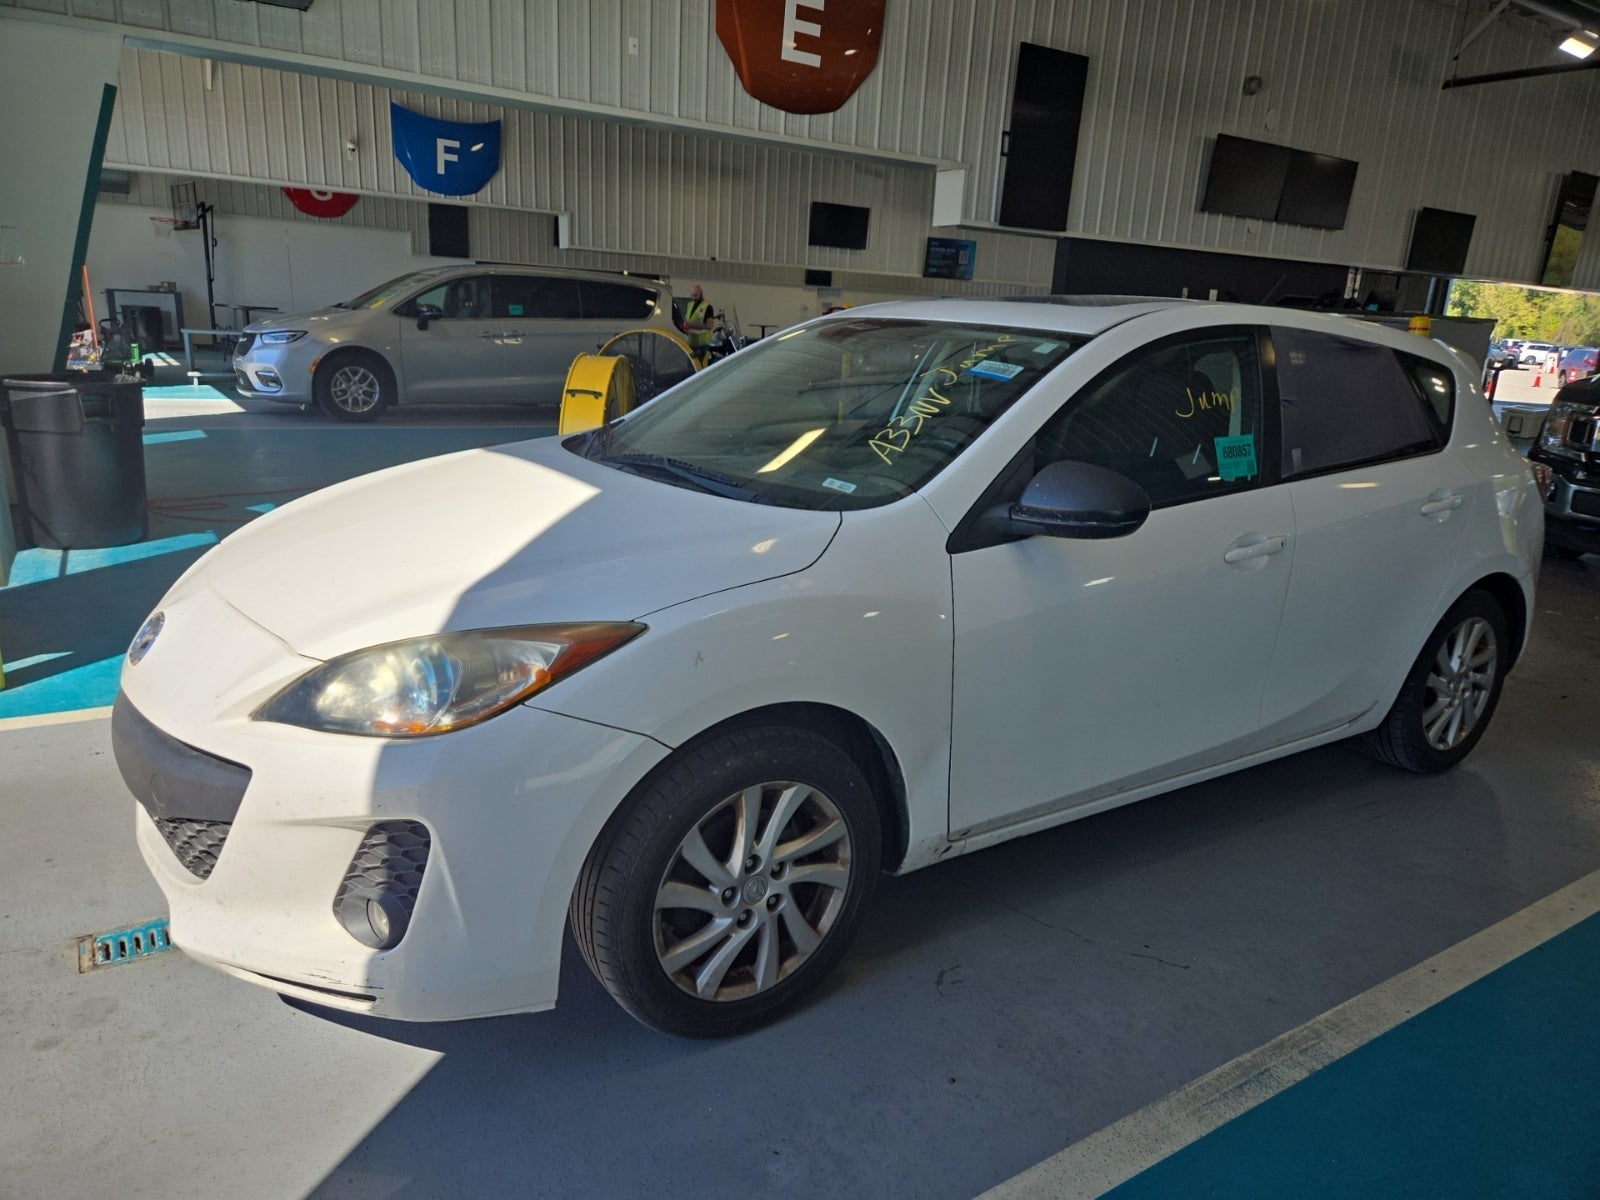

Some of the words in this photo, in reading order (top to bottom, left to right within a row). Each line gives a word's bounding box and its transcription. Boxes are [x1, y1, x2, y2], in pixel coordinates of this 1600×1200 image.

[781, 0, 825, 68] E
[436, 138, 460, 175] F
[1175, 387, 1239, 417] Jump
[1223, 443, 1251, 459] 680857
